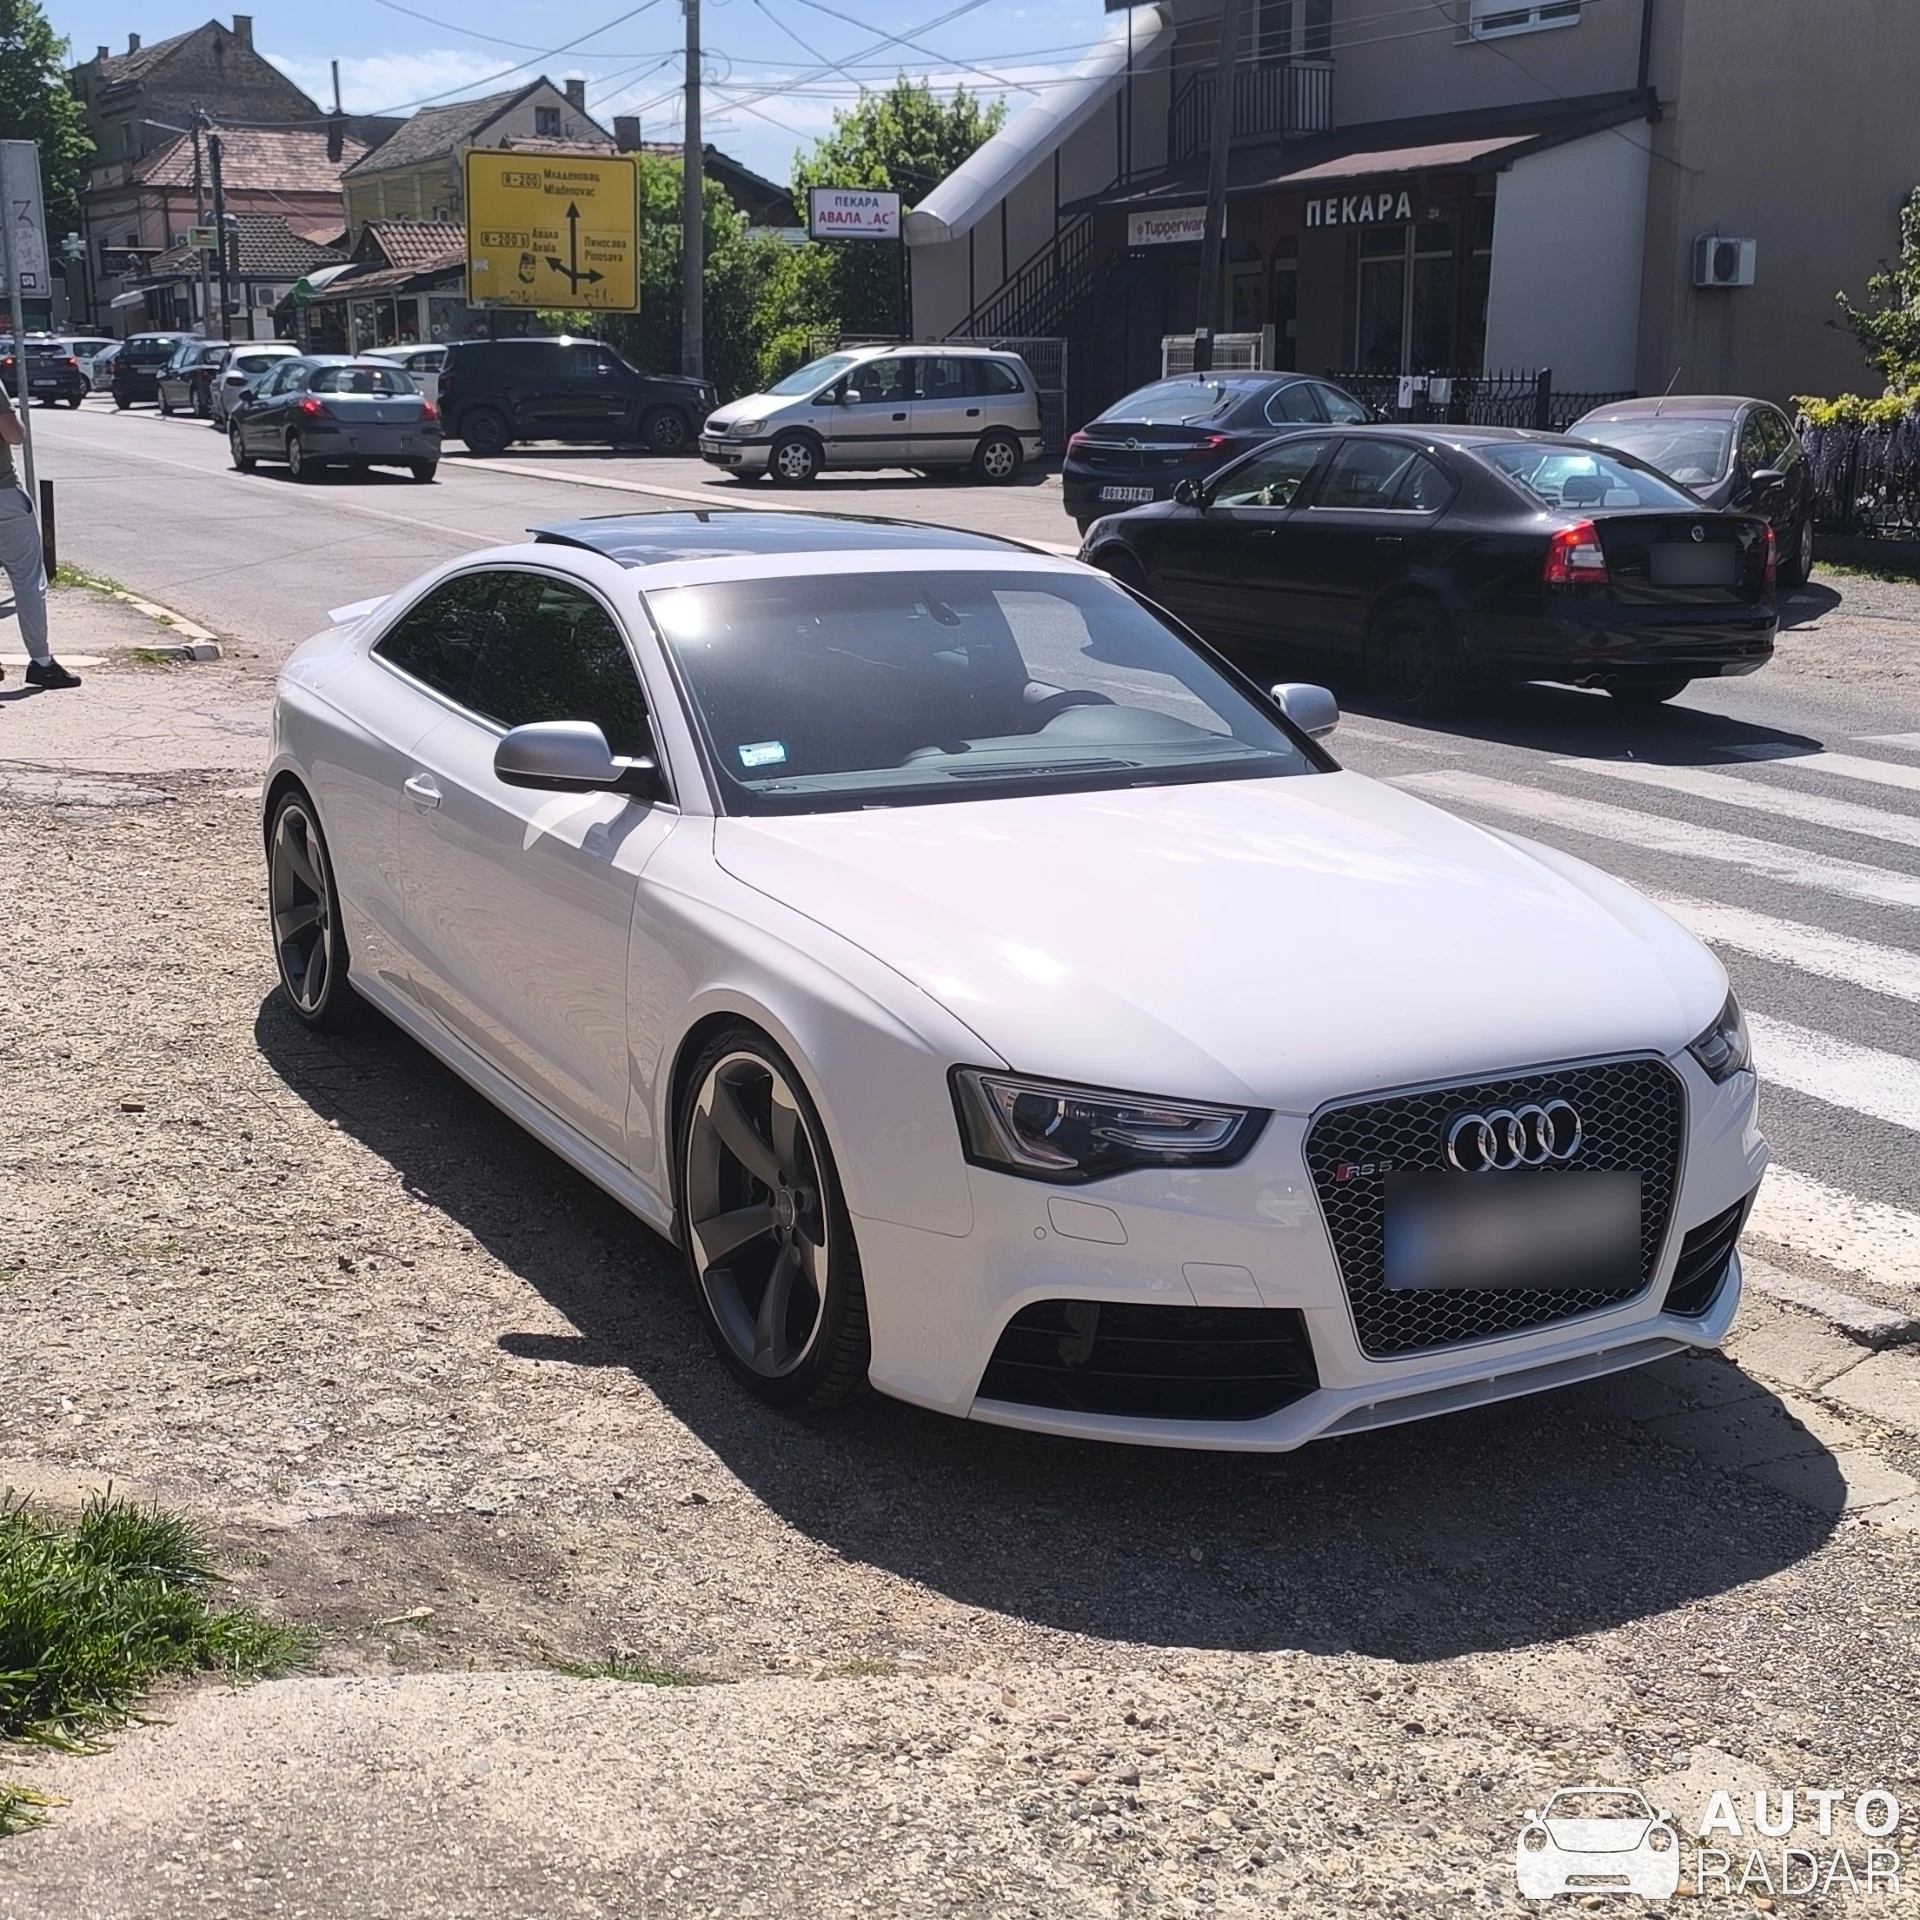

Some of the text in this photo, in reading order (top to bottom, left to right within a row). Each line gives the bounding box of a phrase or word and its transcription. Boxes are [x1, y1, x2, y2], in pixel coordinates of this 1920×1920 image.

[543, 168, 600, 183] Младеновац
[543, 184, 596, 197] Mladenovac
[834, 196, 879, 208] ПЕКАРА
[1306, 191, 1412, 227] ПЕКАРА
[818, 210, 862, 224] АВАЛА
[531, 227, 559, 240] Авала
[1144, 219, 1205, 238] Tupperwar
[531, 242, 557, 253] Avala
[584, 236, 627, 249] Пиносава
[584, 250, 623, 262] Pinosava
